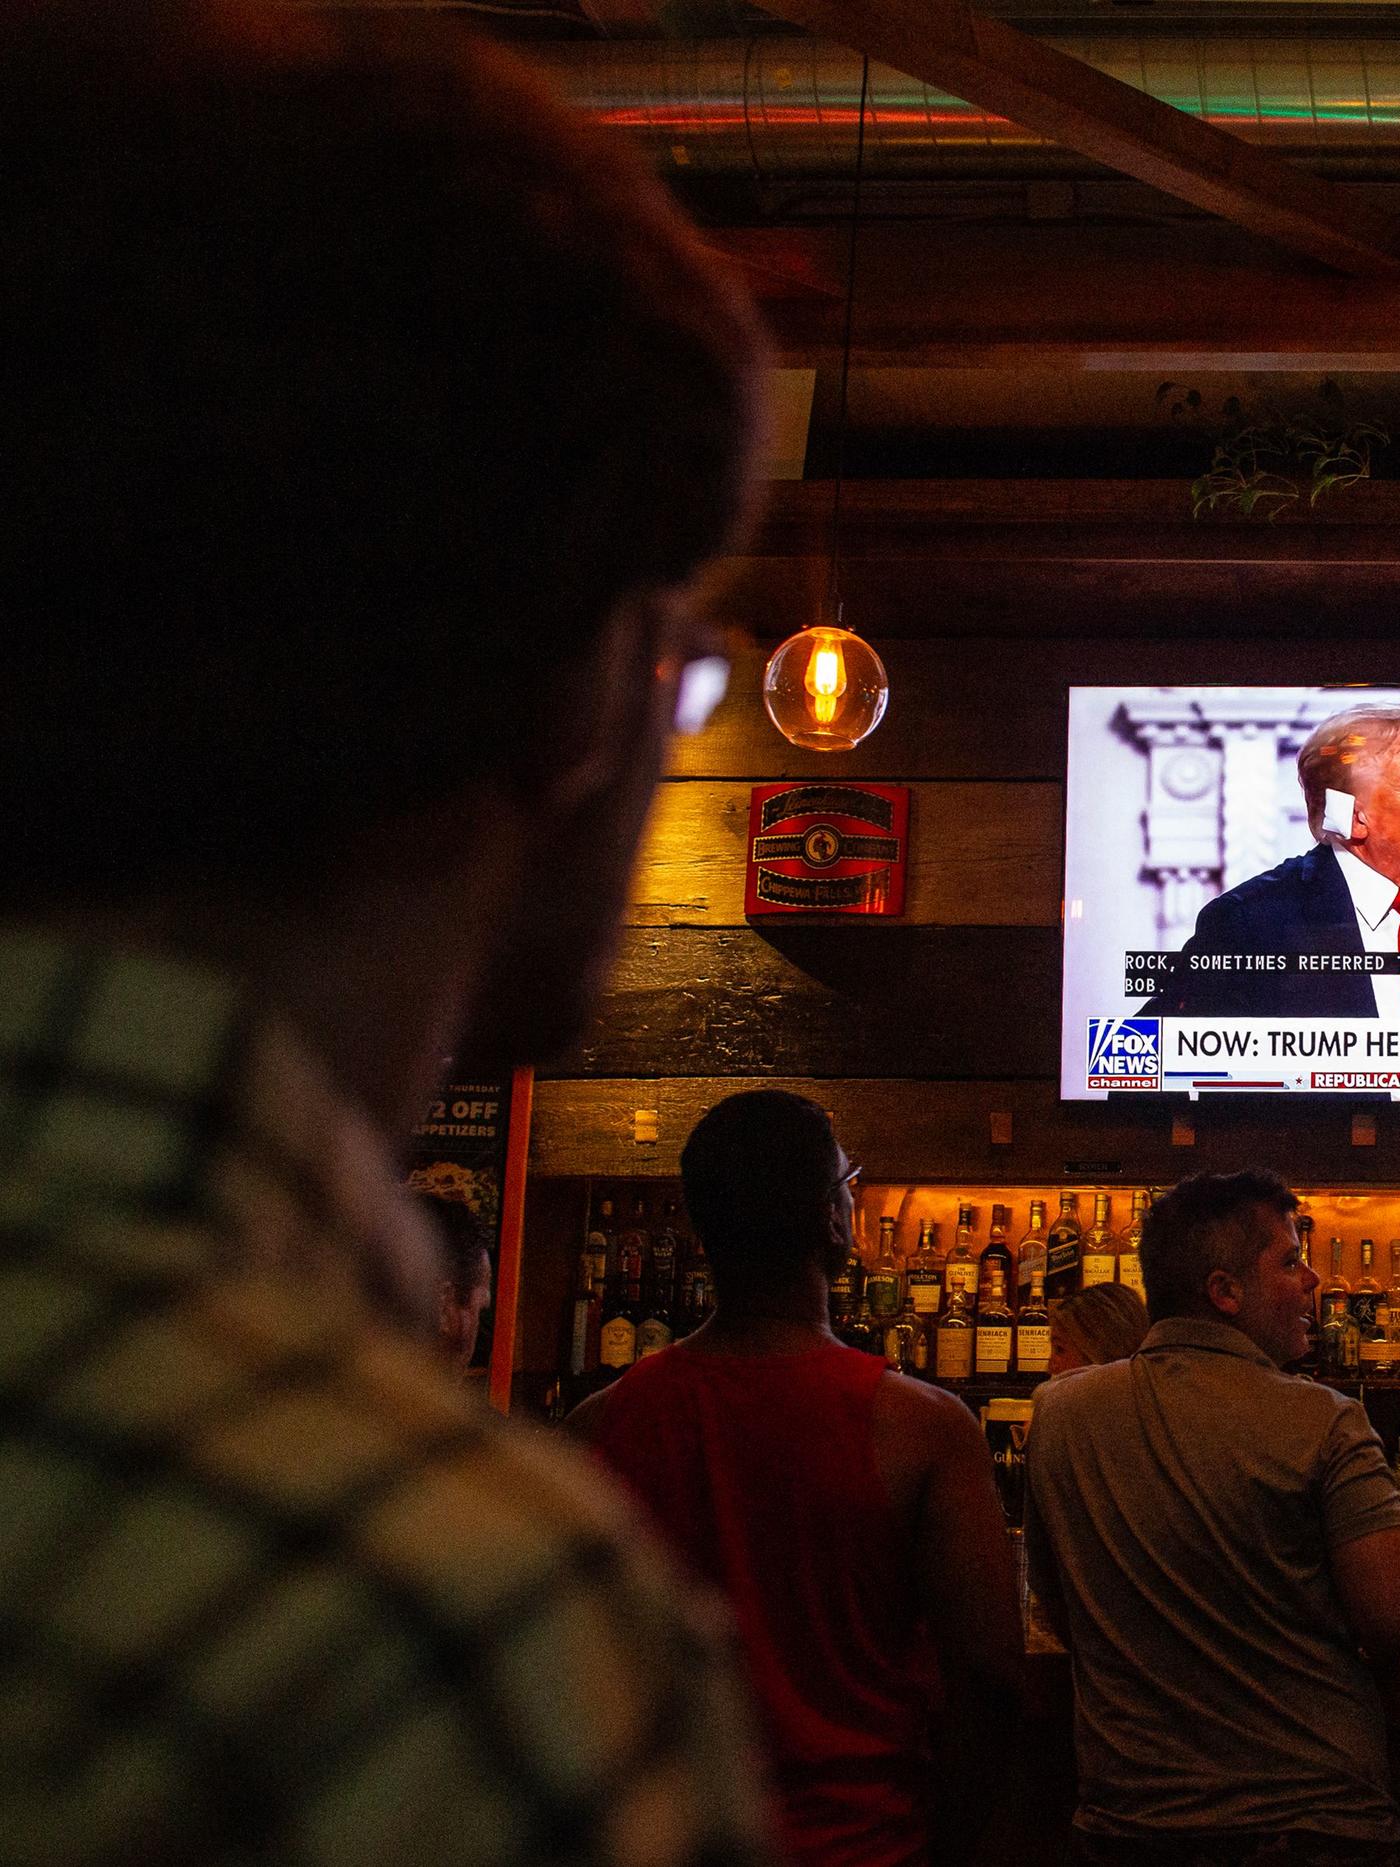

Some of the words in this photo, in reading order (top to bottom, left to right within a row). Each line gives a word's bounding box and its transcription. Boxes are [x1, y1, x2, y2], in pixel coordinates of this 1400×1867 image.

[760, 876, 811, 900] CHIPPEWA
[1125, 956, 1175, 972] ROCK,
[1190, 956, 1287, 970] SOMETIMES
[1299, 956, 1385, 970] REFERRED
[1125, 979, 1165, 993] BOB.
[1112, 1034, 1157, 1054] FOX
[1178, 1030, 1259, 1057] NOW:
[1267, 1031, 1358, 1057] TRUMP
[1098, 1055, 1158, 1075] NEWS
[1089, 1077, 1158, 1089] channel
[451, 1101, 499, 1119] OFF
